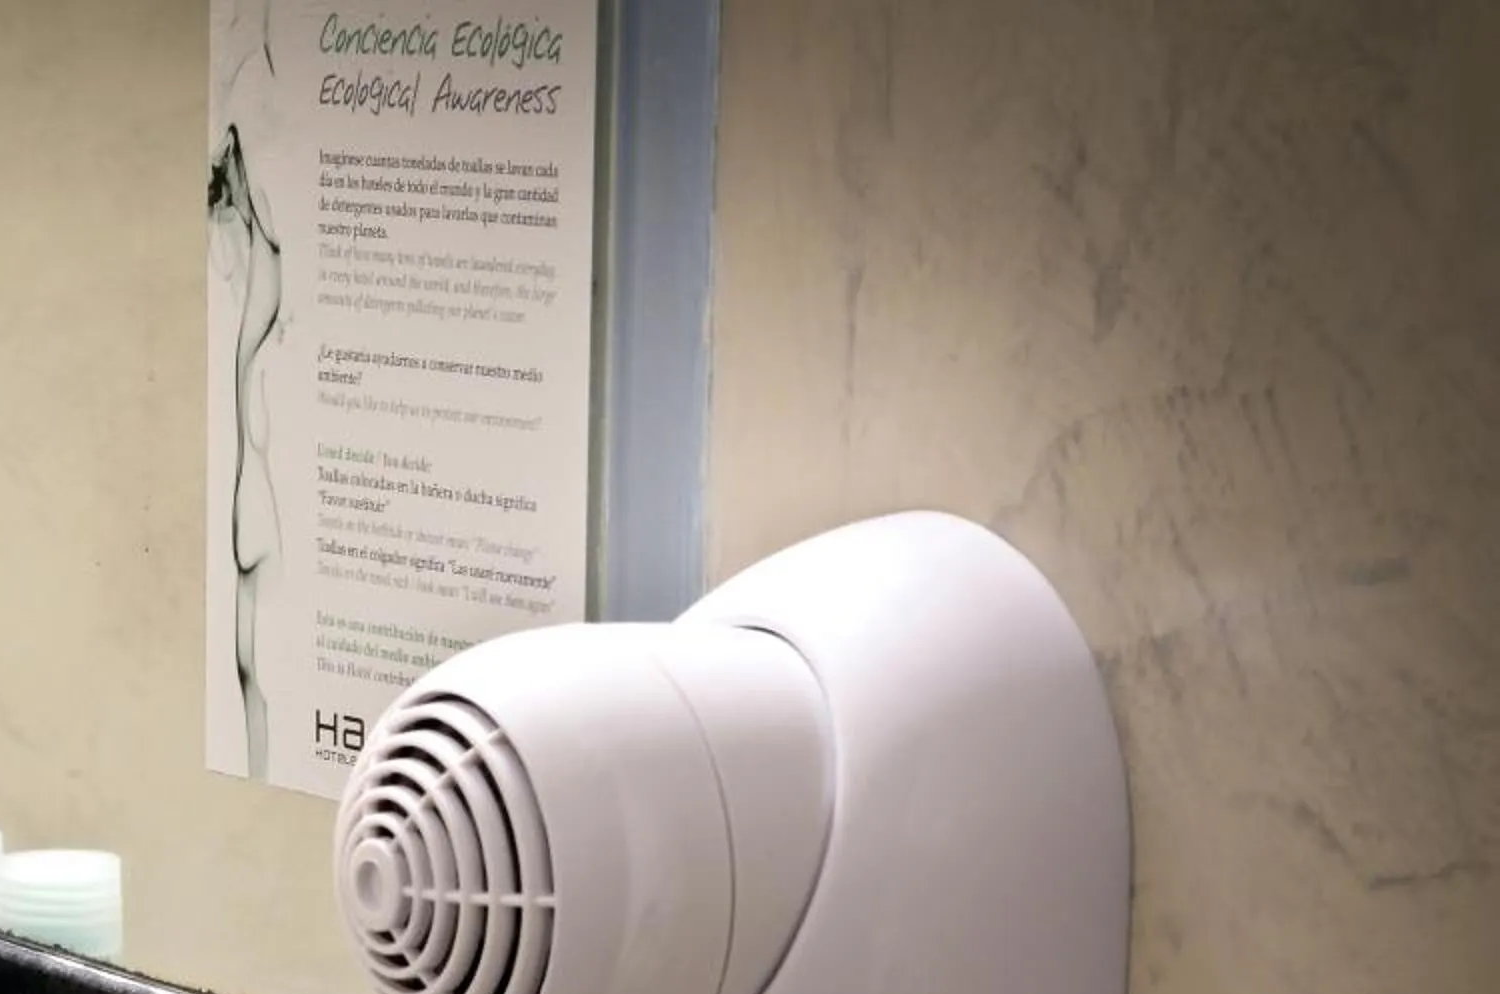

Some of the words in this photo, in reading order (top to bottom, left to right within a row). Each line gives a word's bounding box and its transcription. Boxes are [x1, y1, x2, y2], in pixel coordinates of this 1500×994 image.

[319, 12, 439, 60] Conciencia
[451, 15, 563, 68] Ecológica
[319, 71, 421, 116] Ecological
[432, 73, 562, 115] Awareness
